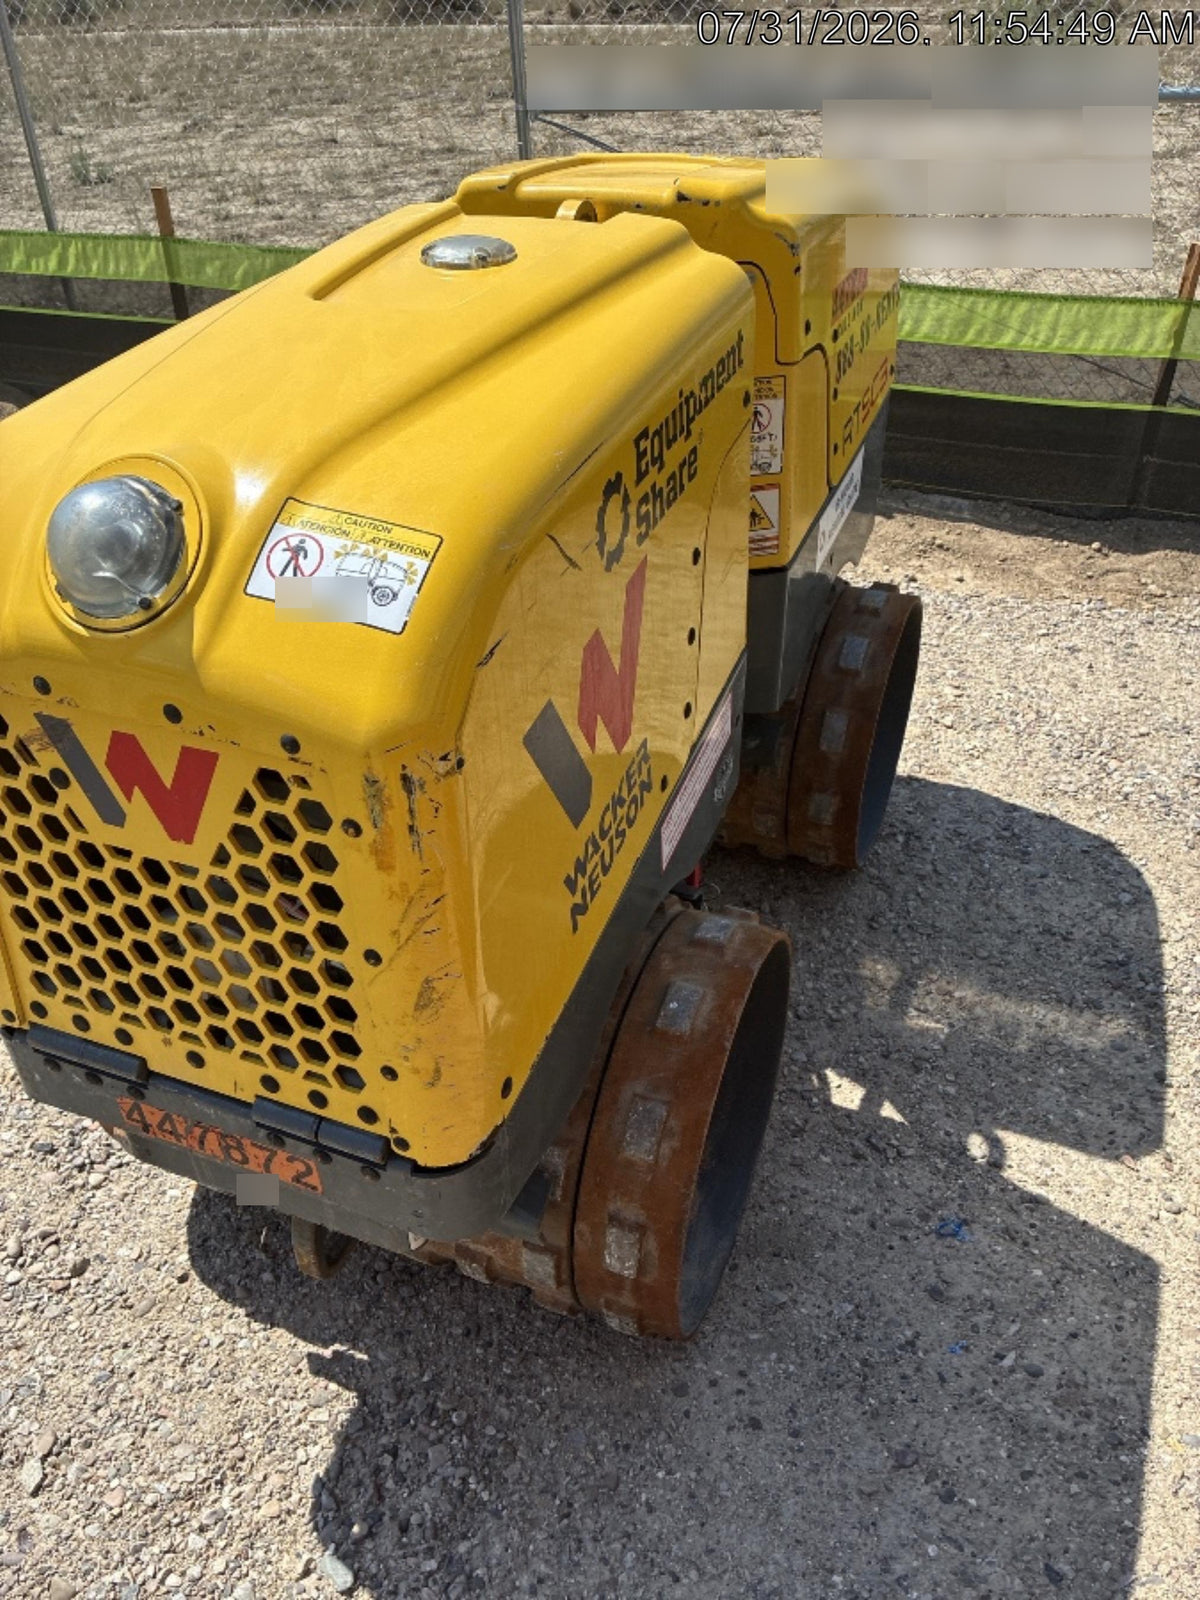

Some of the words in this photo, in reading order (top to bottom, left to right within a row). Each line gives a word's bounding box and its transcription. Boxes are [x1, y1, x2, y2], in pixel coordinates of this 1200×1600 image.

[633, 329, 744, 487] Equipment
[344, 516, 394, 535] CAUTION
[369, 536, 431, 558] ATTENTION
[563, 737, 652, 897] WACKER
[570, 764, 653, 934] NEUSON
[125, 1101, 320, 1192] 447872
